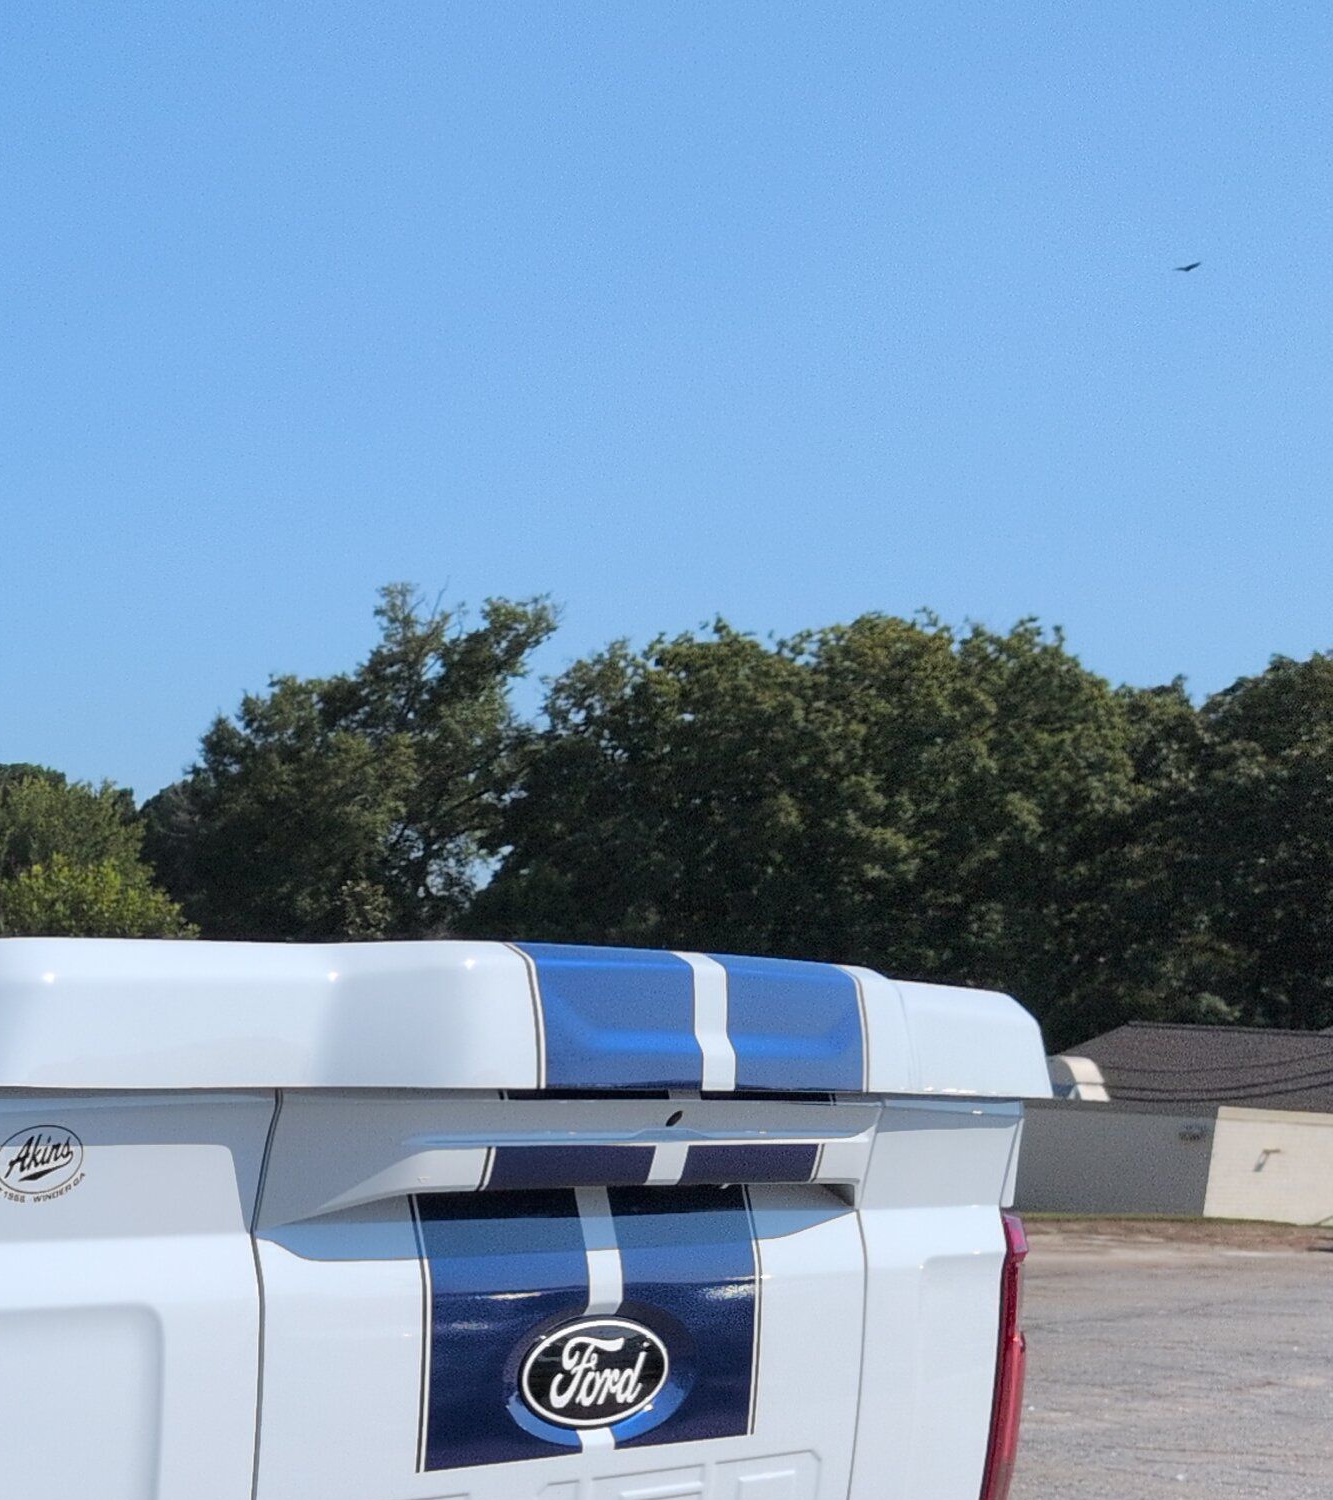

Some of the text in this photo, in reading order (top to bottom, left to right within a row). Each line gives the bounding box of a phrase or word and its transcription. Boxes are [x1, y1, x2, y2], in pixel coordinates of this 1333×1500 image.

[4, 1133, 73, 1181] Akins
[33, 1183, 73, 1203] WINDER
[548, 1336, 645, 1408] Ford
